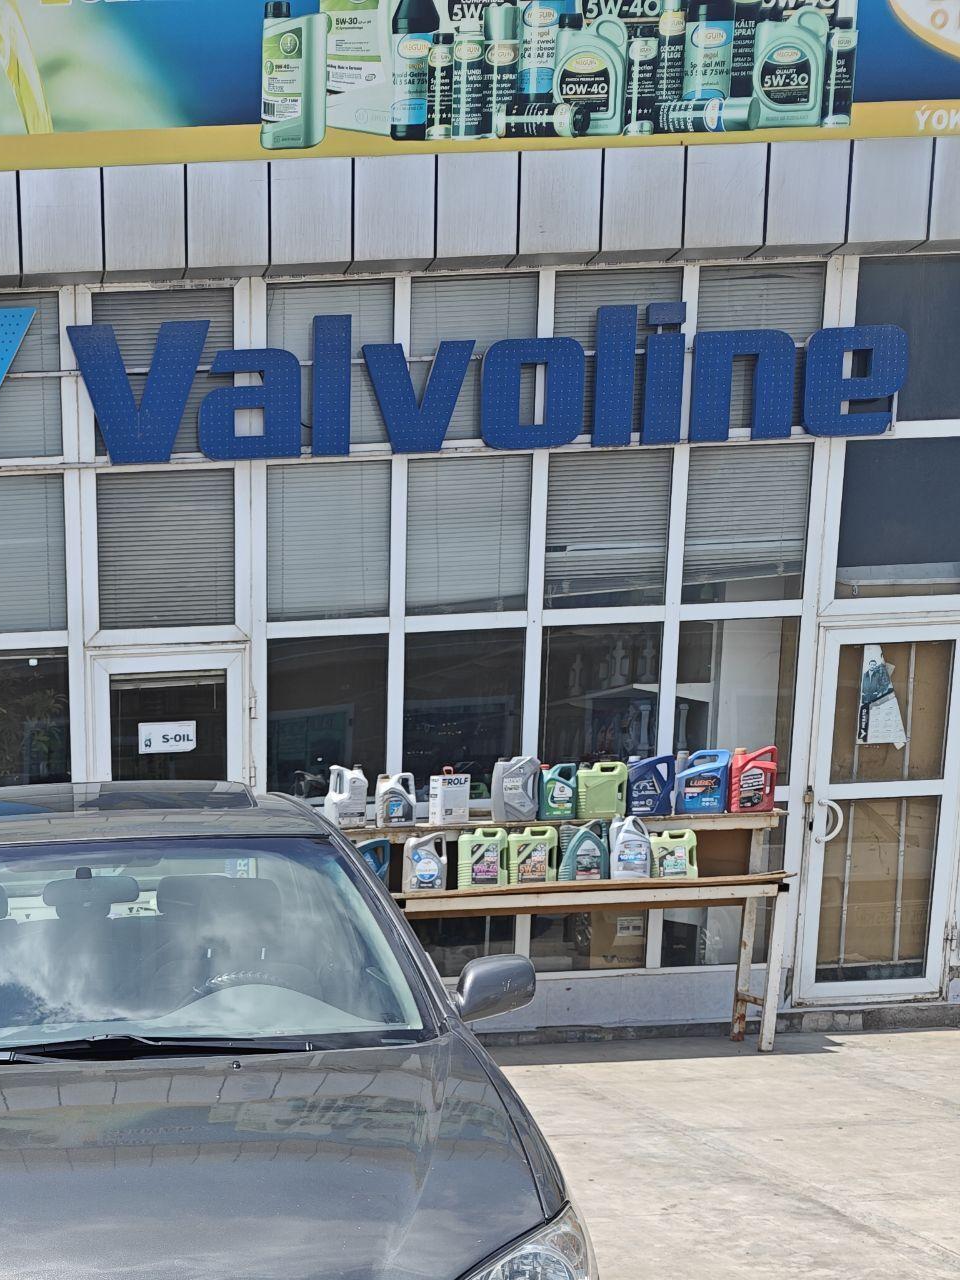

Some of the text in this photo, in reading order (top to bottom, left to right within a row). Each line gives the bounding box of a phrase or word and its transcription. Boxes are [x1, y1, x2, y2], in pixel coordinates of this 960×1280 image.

[763, 73, 809, 88] 5W-30
[561, 83, 609, 95] 10W-40
[66, 300, 908, 465] Valvoline
[161, 733, 194, 743] S-OIL
[447, 777, 469, 787] ROLF
